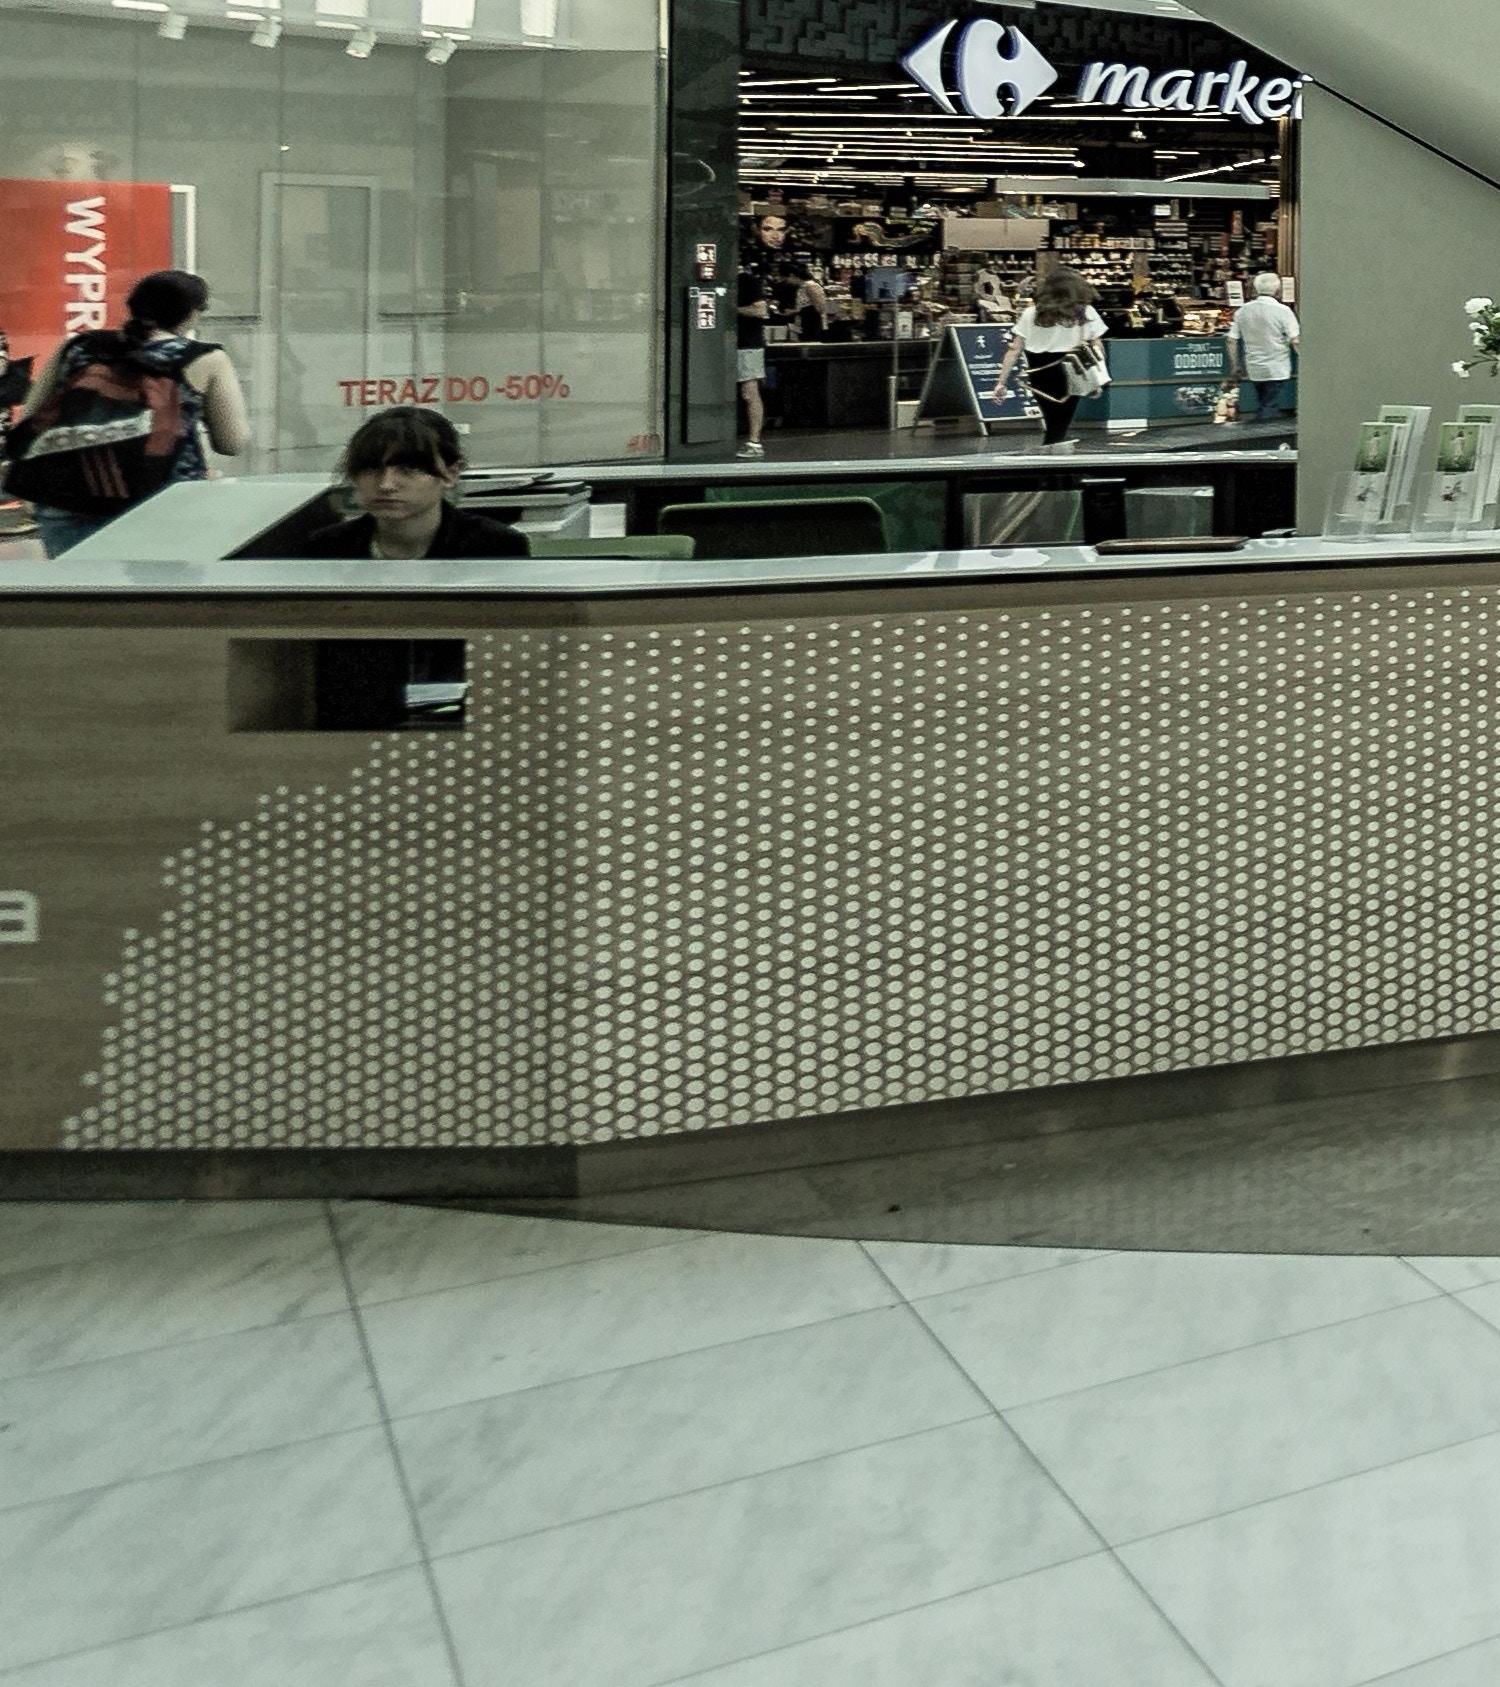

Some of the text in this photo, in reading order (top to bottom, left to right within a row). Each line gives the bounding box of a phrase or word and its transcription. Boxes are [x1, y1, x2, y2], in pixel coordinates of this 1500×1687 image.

[64, 196, 108, 339] WYPR
[338, 373, 571, 408] TERAZ DO -50%
